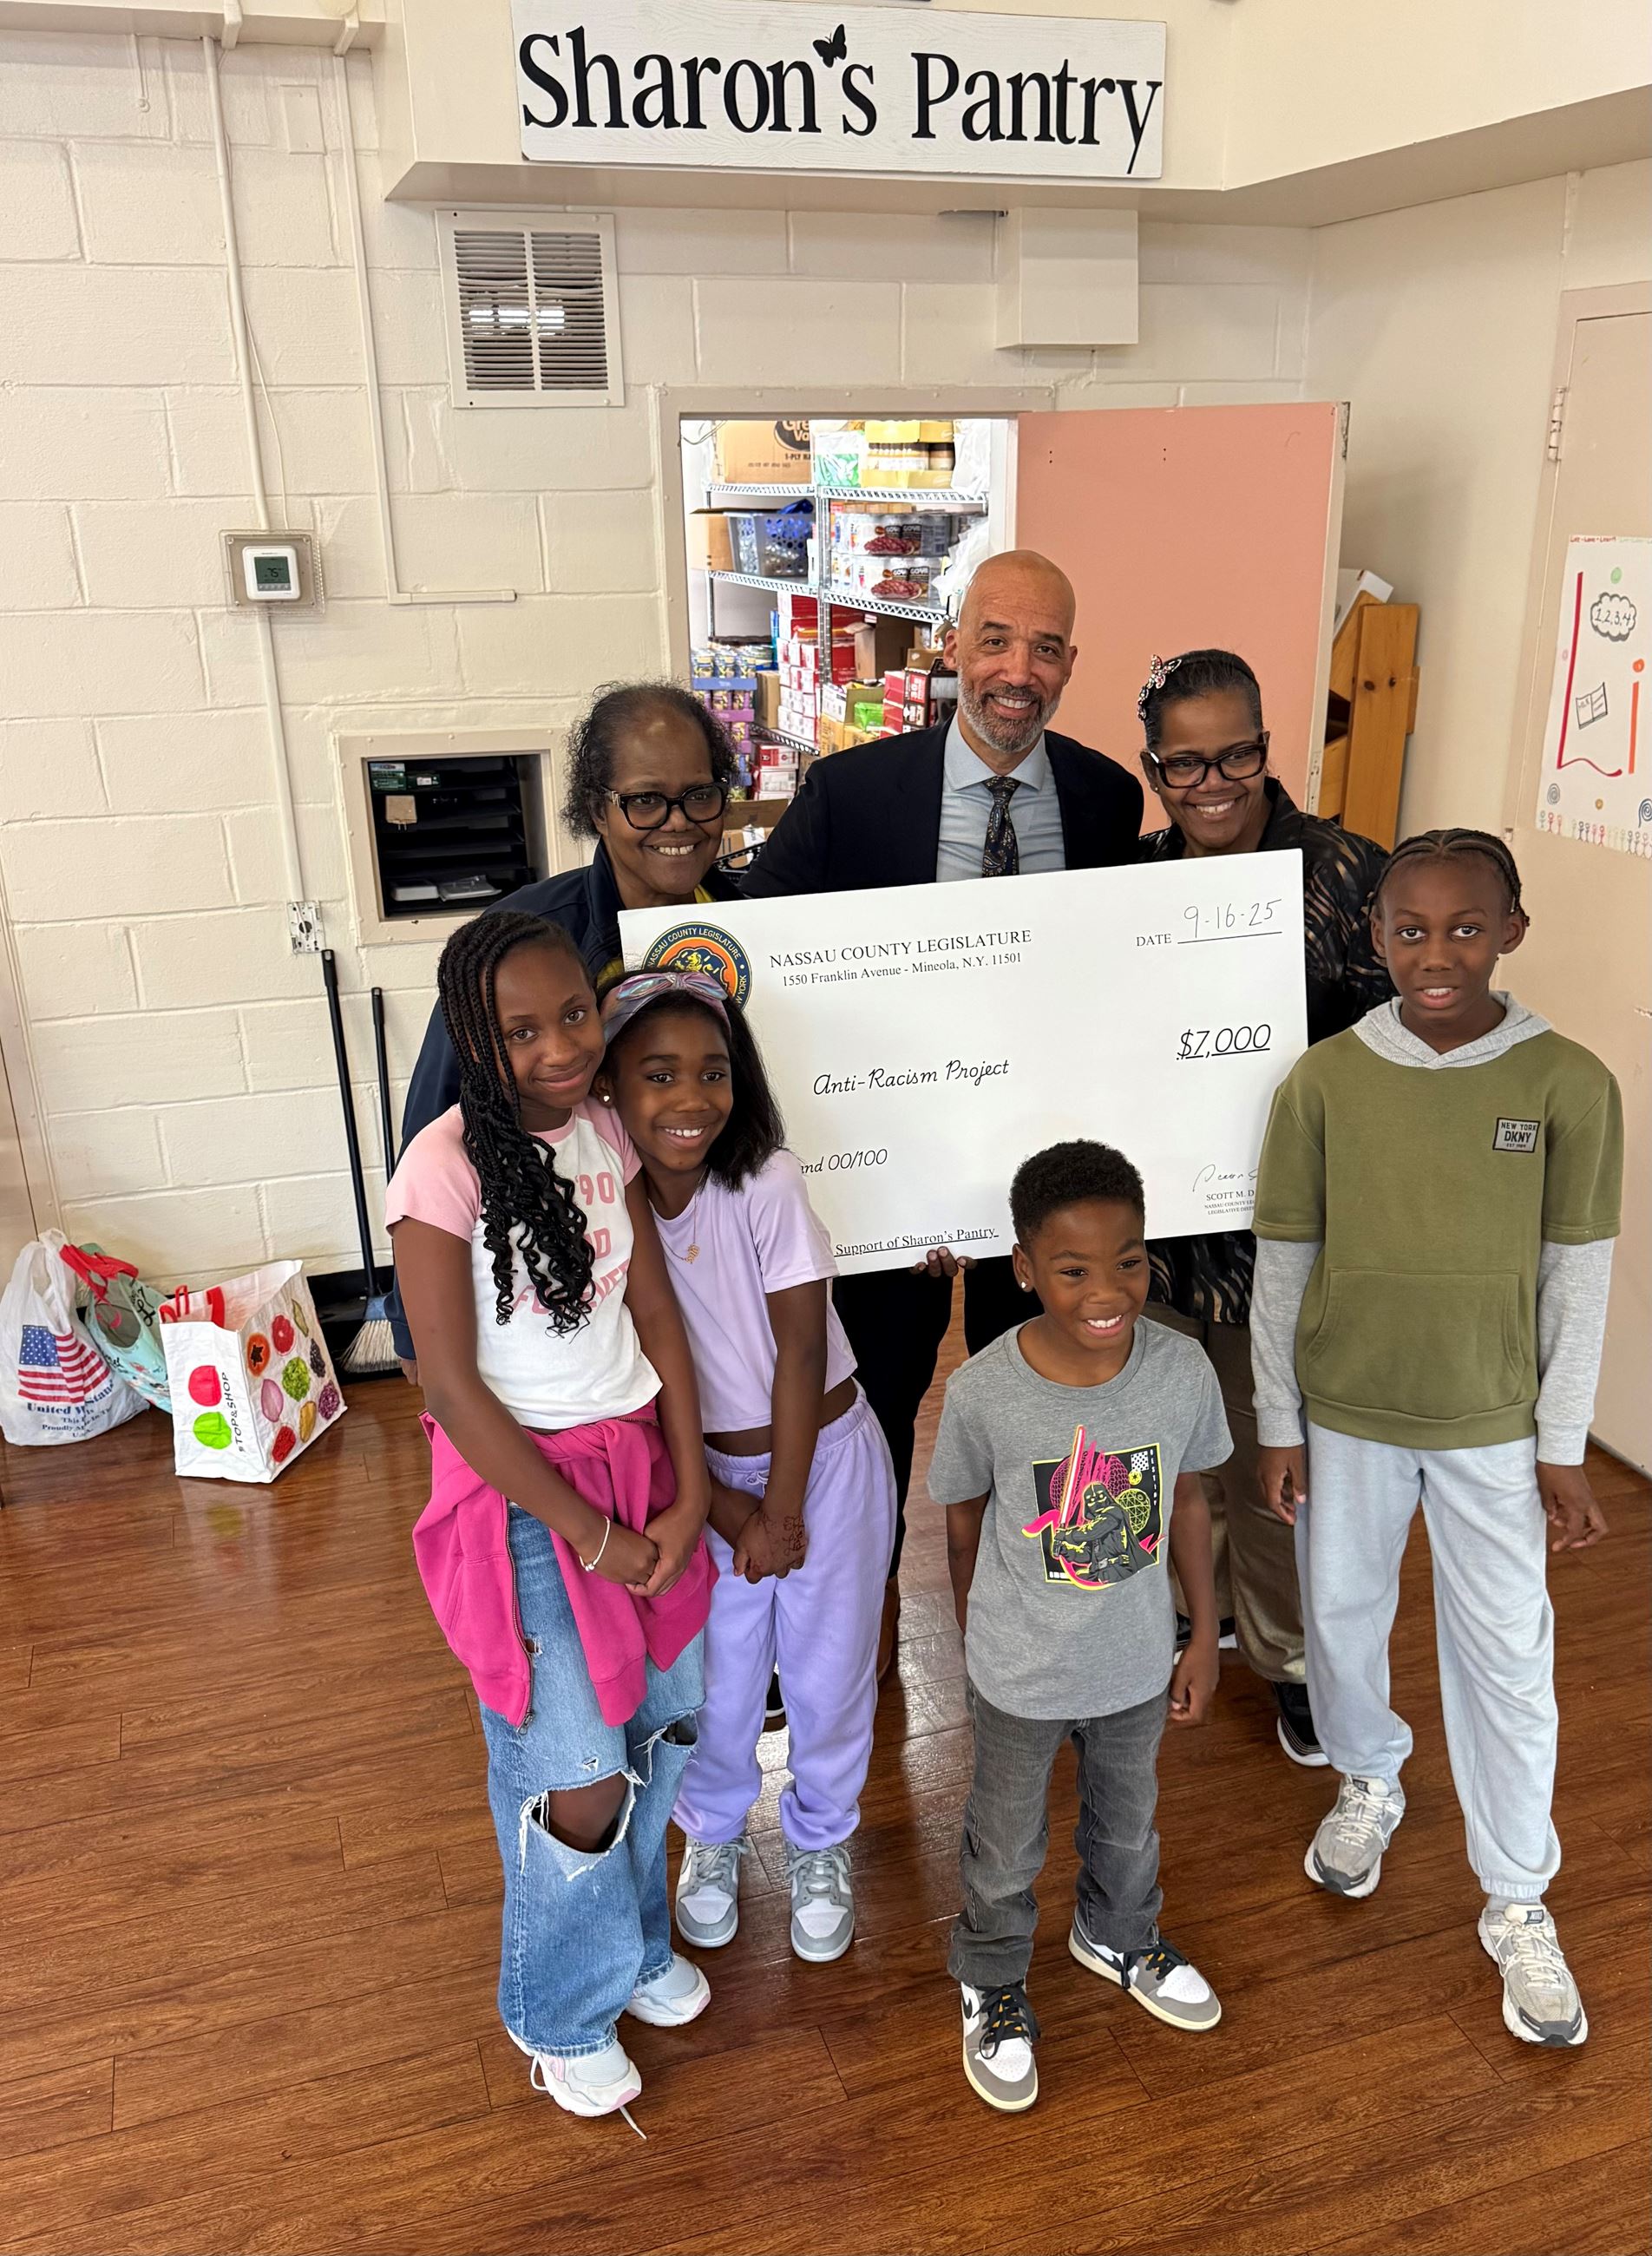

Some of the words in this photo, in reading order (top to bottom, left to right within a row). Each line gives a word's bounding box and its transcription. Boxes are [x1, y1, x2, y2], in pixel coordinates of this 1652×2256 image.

[910, 53, 1163, 174] Pantry
[667, 928, 698, 943] COUNTY
[698, 928, 742, 961] LEGISLATURE
[770, 949, 837, 968] NASSAU
[841, 941, 913, 961] COUNTY
[916, 929, 1032, 954] LEGISLATURE
[1136, 934, 1172, 947] DATE
[783, 974, 808, 987] 1550
[810, 968, 858, 984] Franklin
[861, 965, 902, 979] Avenue
[911, 958, 960, 974] Mineola,
[962, 954, 989, 968] N.Y.
[992, 952, 1022, 966] 11501
[1176, 1023, 1271, 1060] $7,000
[813, 1067, 938, 1095] Anti-Racism
[945, 1059, 1010, 1086] Project
[1500, 1121, 1518, 1130] NEW
[1504, 1131, 1531, 1143] DKNY
[827, 1148, 888, 1171] 00/100
[1206, 1191, 1234, 1202] SCOTT
[1248, 1189, 1255, 1197] D
[836, 1242, 883, 1256] Support
[887, 1236, 899, 1249] of
[901, 1230, 954, 1247] Sharon's
[956, 1226, 995, 1241] Pantry
[27, 1402, 71, 1414] United
